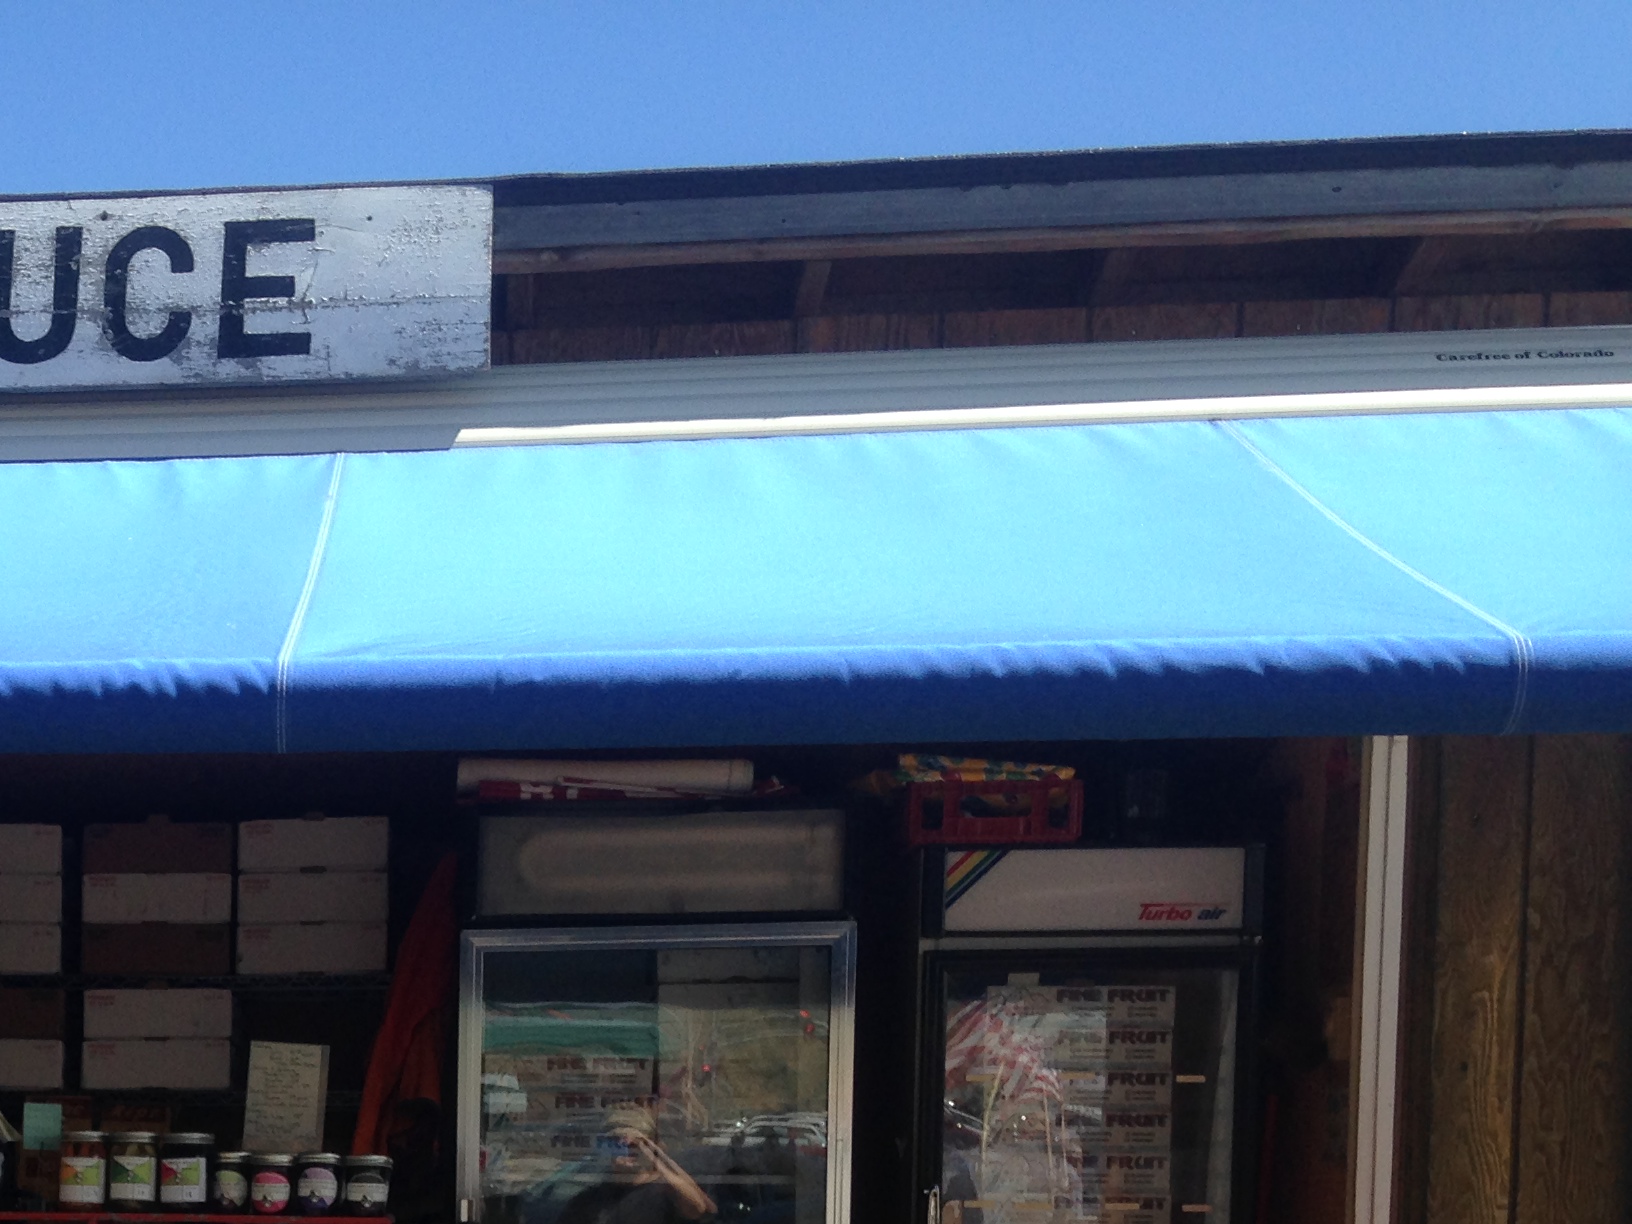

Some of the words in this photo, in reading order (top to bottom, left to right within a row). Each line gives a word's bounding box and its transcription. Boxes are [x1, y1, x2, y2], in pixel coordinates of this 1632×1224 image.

[1435, 351, 1511, 362] Carefree
[1514, 350, 1532, 360] of
[1537, 349, 1615, 360] Colorado
[1138, 903, 1192, 921] Turbo
[1197, 906, 1227, 921] air
[1107, 988, 1170, 1003] FRUIT
[1108, 1030, 1170, 1044] FRUIT
[1107, 1072, 1170, 1086] FRUIT
[1106, 1155, 1168, 1169] FRUIT
